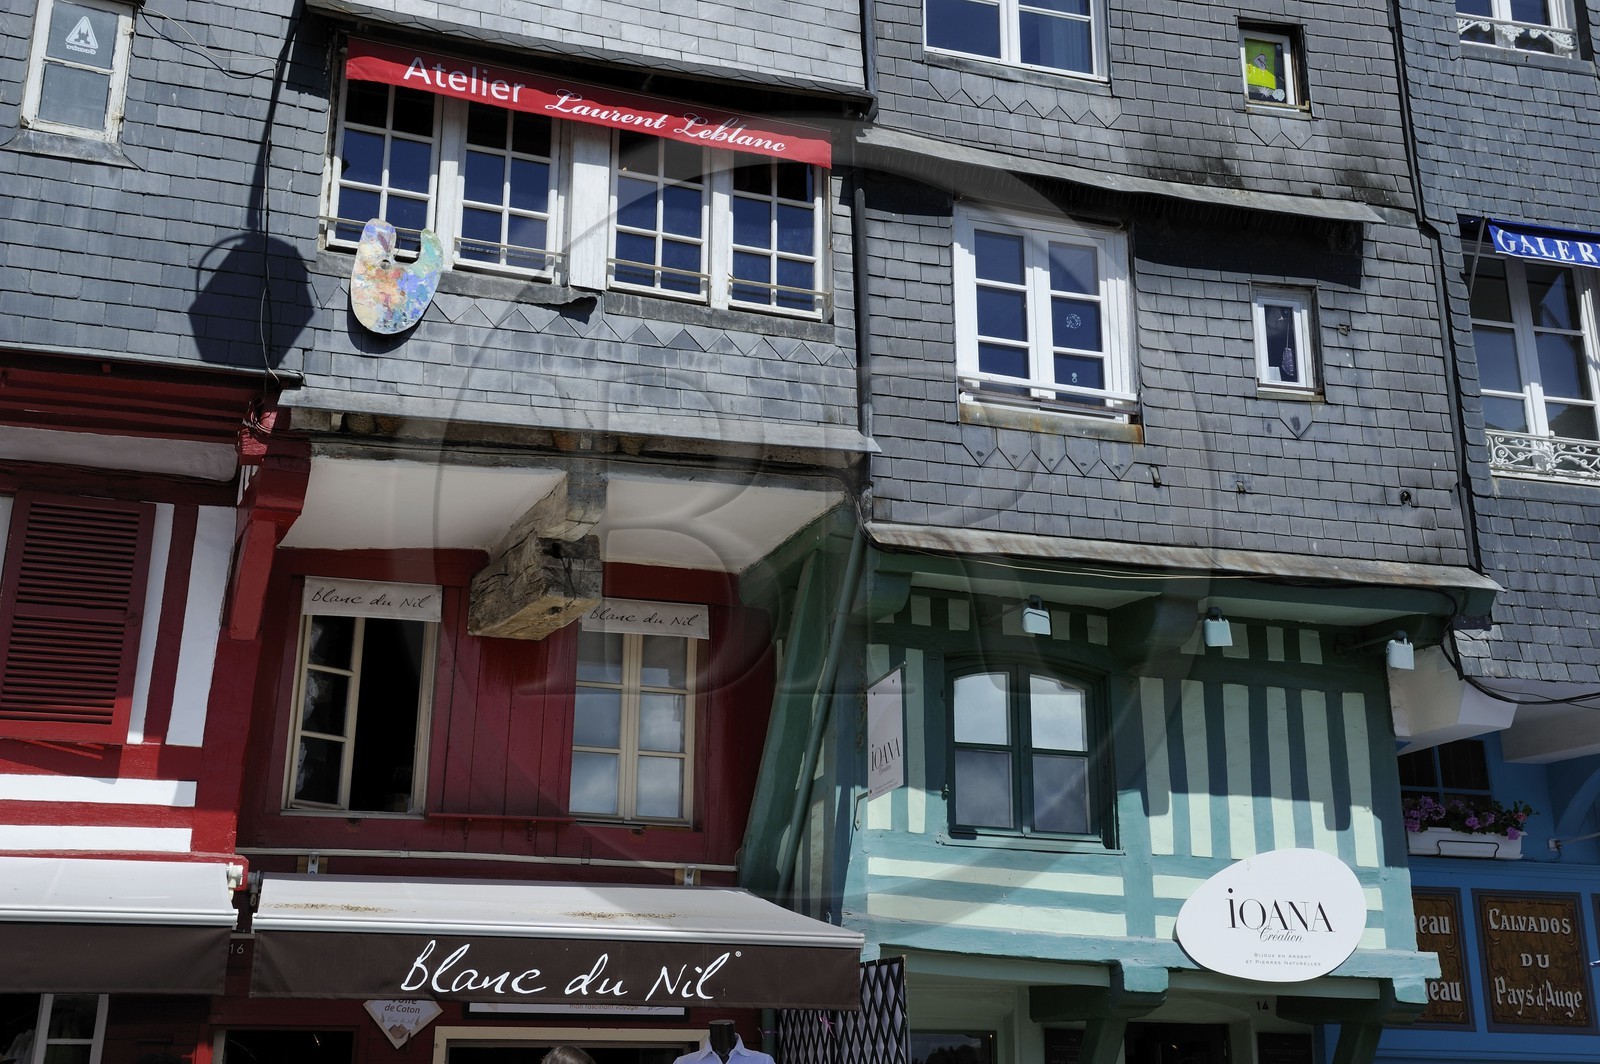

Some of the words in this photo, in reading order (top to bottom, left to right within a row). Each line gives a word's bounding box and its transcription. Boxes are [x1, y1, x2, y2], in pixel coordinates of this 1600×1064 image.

[403, 56, 526, 103] Atelier
[545, 89, 668, 129] Laurent
[673, 112, 786, 152] Leblanc
[1496, 229, 1600, 263] GALER
[311, 587, 363, 605] Blanc
[369, 593, 392, 607] du
[399, 594, 432, 609] Nil
[589, 604, 637, 622] Blanc
[642, 612, 664, 625] du
[670, 614, 699, 627] Nil
[1415, 915, 1452, 935] eau
[1489, 908, 1571, 935] CALVADOS
[1258, 926, 1304, 943] Création
[230, 943, 245, 954] 16
[400, 939, 547, 994] Blanc
[564, 953, 628, 996] du
[1520, 953, 1550, 969] DU
[1425, 981, 1462, 1002] eau
[1494, 976, 1534, 1016] Pays
[1536, 980, 1583, 1018] d'Auge
[384, 1003, 395, 1012] de
[396, 1004, 421, 1014] Coton
[1256, 1000, 1270, 1011] 14
